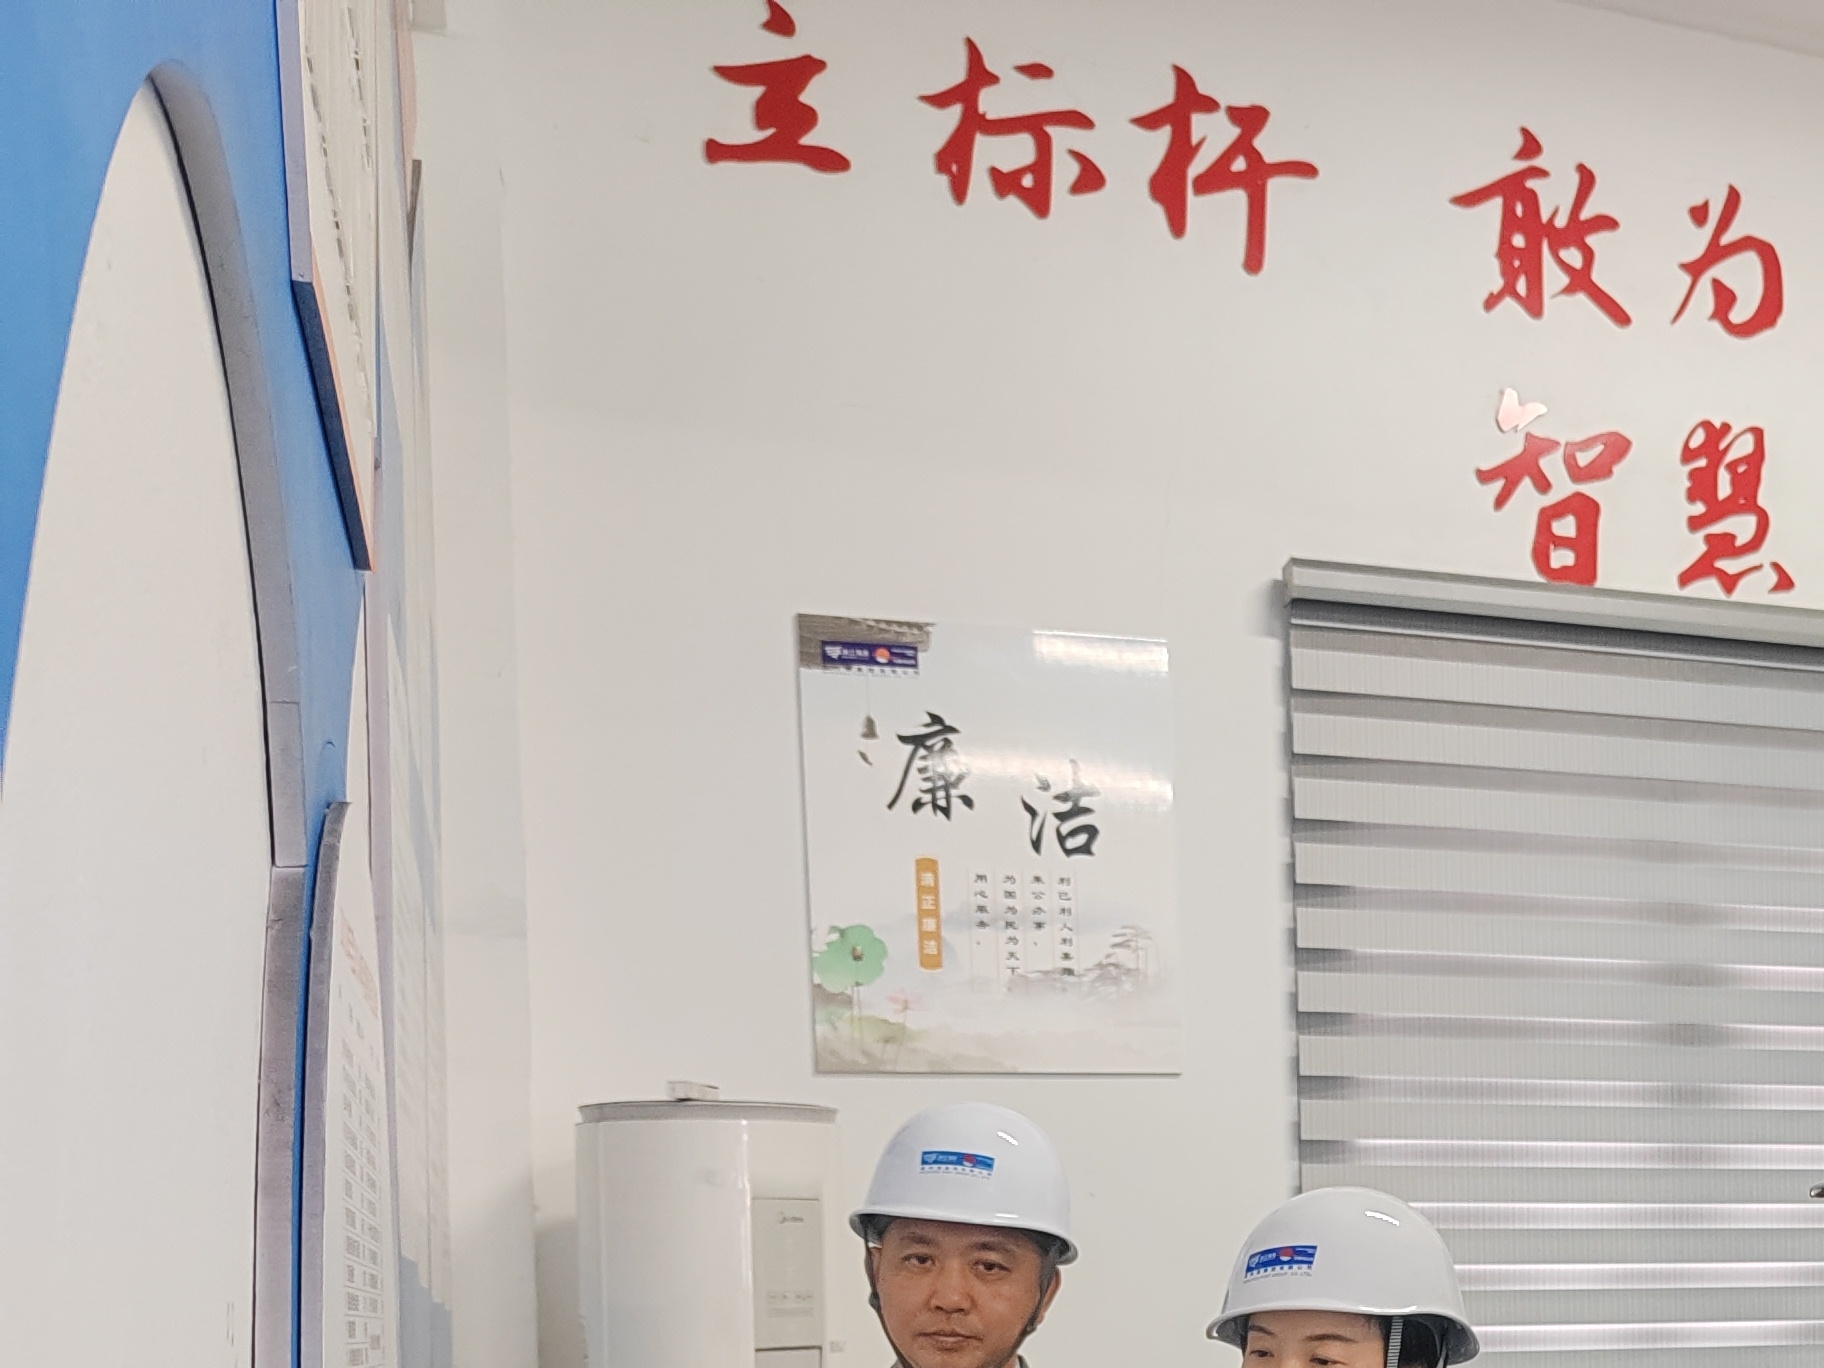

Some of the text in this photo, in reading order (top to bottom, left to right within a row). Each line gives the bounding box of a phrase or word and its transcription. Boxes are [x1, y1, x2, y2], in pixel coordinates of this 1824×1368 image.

[705, 0, 1318, 273] 立标杆
[887, 711, 1101, 858] 廉洁
